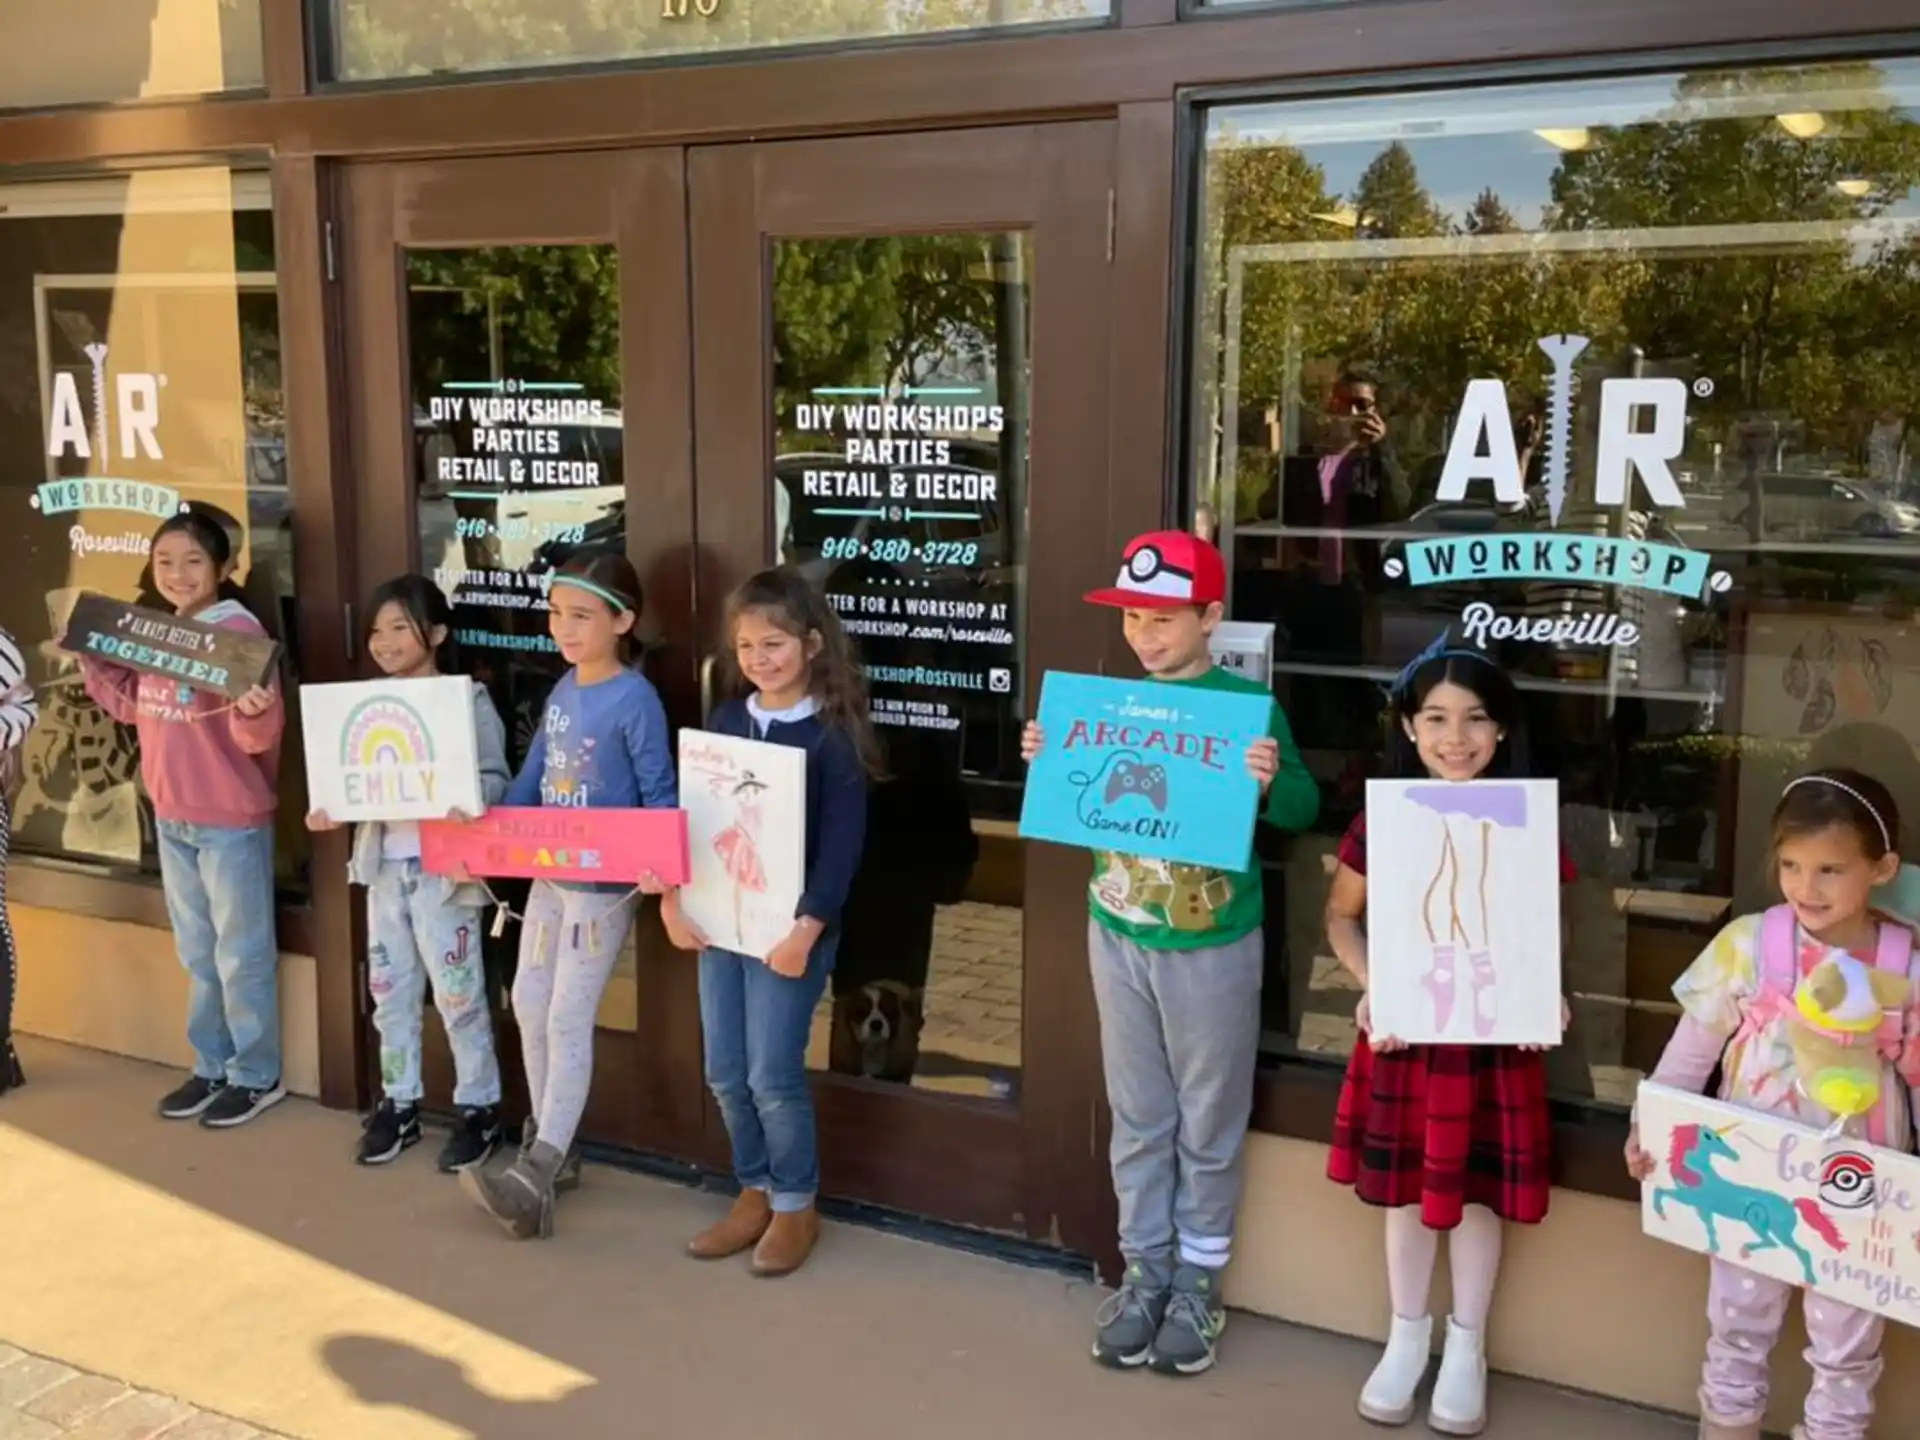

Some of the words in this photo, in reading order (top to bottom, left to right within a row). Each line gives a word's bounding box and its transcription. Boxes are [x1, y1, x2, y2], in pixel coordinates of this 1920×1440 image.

[430, 397, 462, 421] DIY
[468, 397, 602, 426] WORKSHOPS
[796, 404, 835, 430] DIY
[843, 404, 1004, 432] WORKSHOPS
[472, 428, 560, 454] PARTIES
[846, 438, 950, 465] PARTIES
[437, 457, 504, 482] RETAIL
[510, 458, 526, 484] &
[532, 460, 600, 486] DECOR
[803, 470, 882, 497] RETAIL
[889, 472, 908, 498] &
[916, 473, 997, 500] DECOR
[46, 483, 170, 514] WORKSHOP
[69, 524, 152, 558] Roseville
[1424, 541, 1687, 586] WORKSHOP
[489, 570, 512, 586] FOR
[515, 571, 523, 588] A
[861, 595, 887, 613] FOR
[891, 597, 900, 614] A
[905, 597, 986, 619] WORKSHOP
[990, 603, 1007, 620] AT
[1462, 602, 1640, 650] Roseville
[87, 630, 230, 686] TOGETHER
[1063, 719, 1230, 771] ARCADE
[344, 769, 437, 805] EMILY
